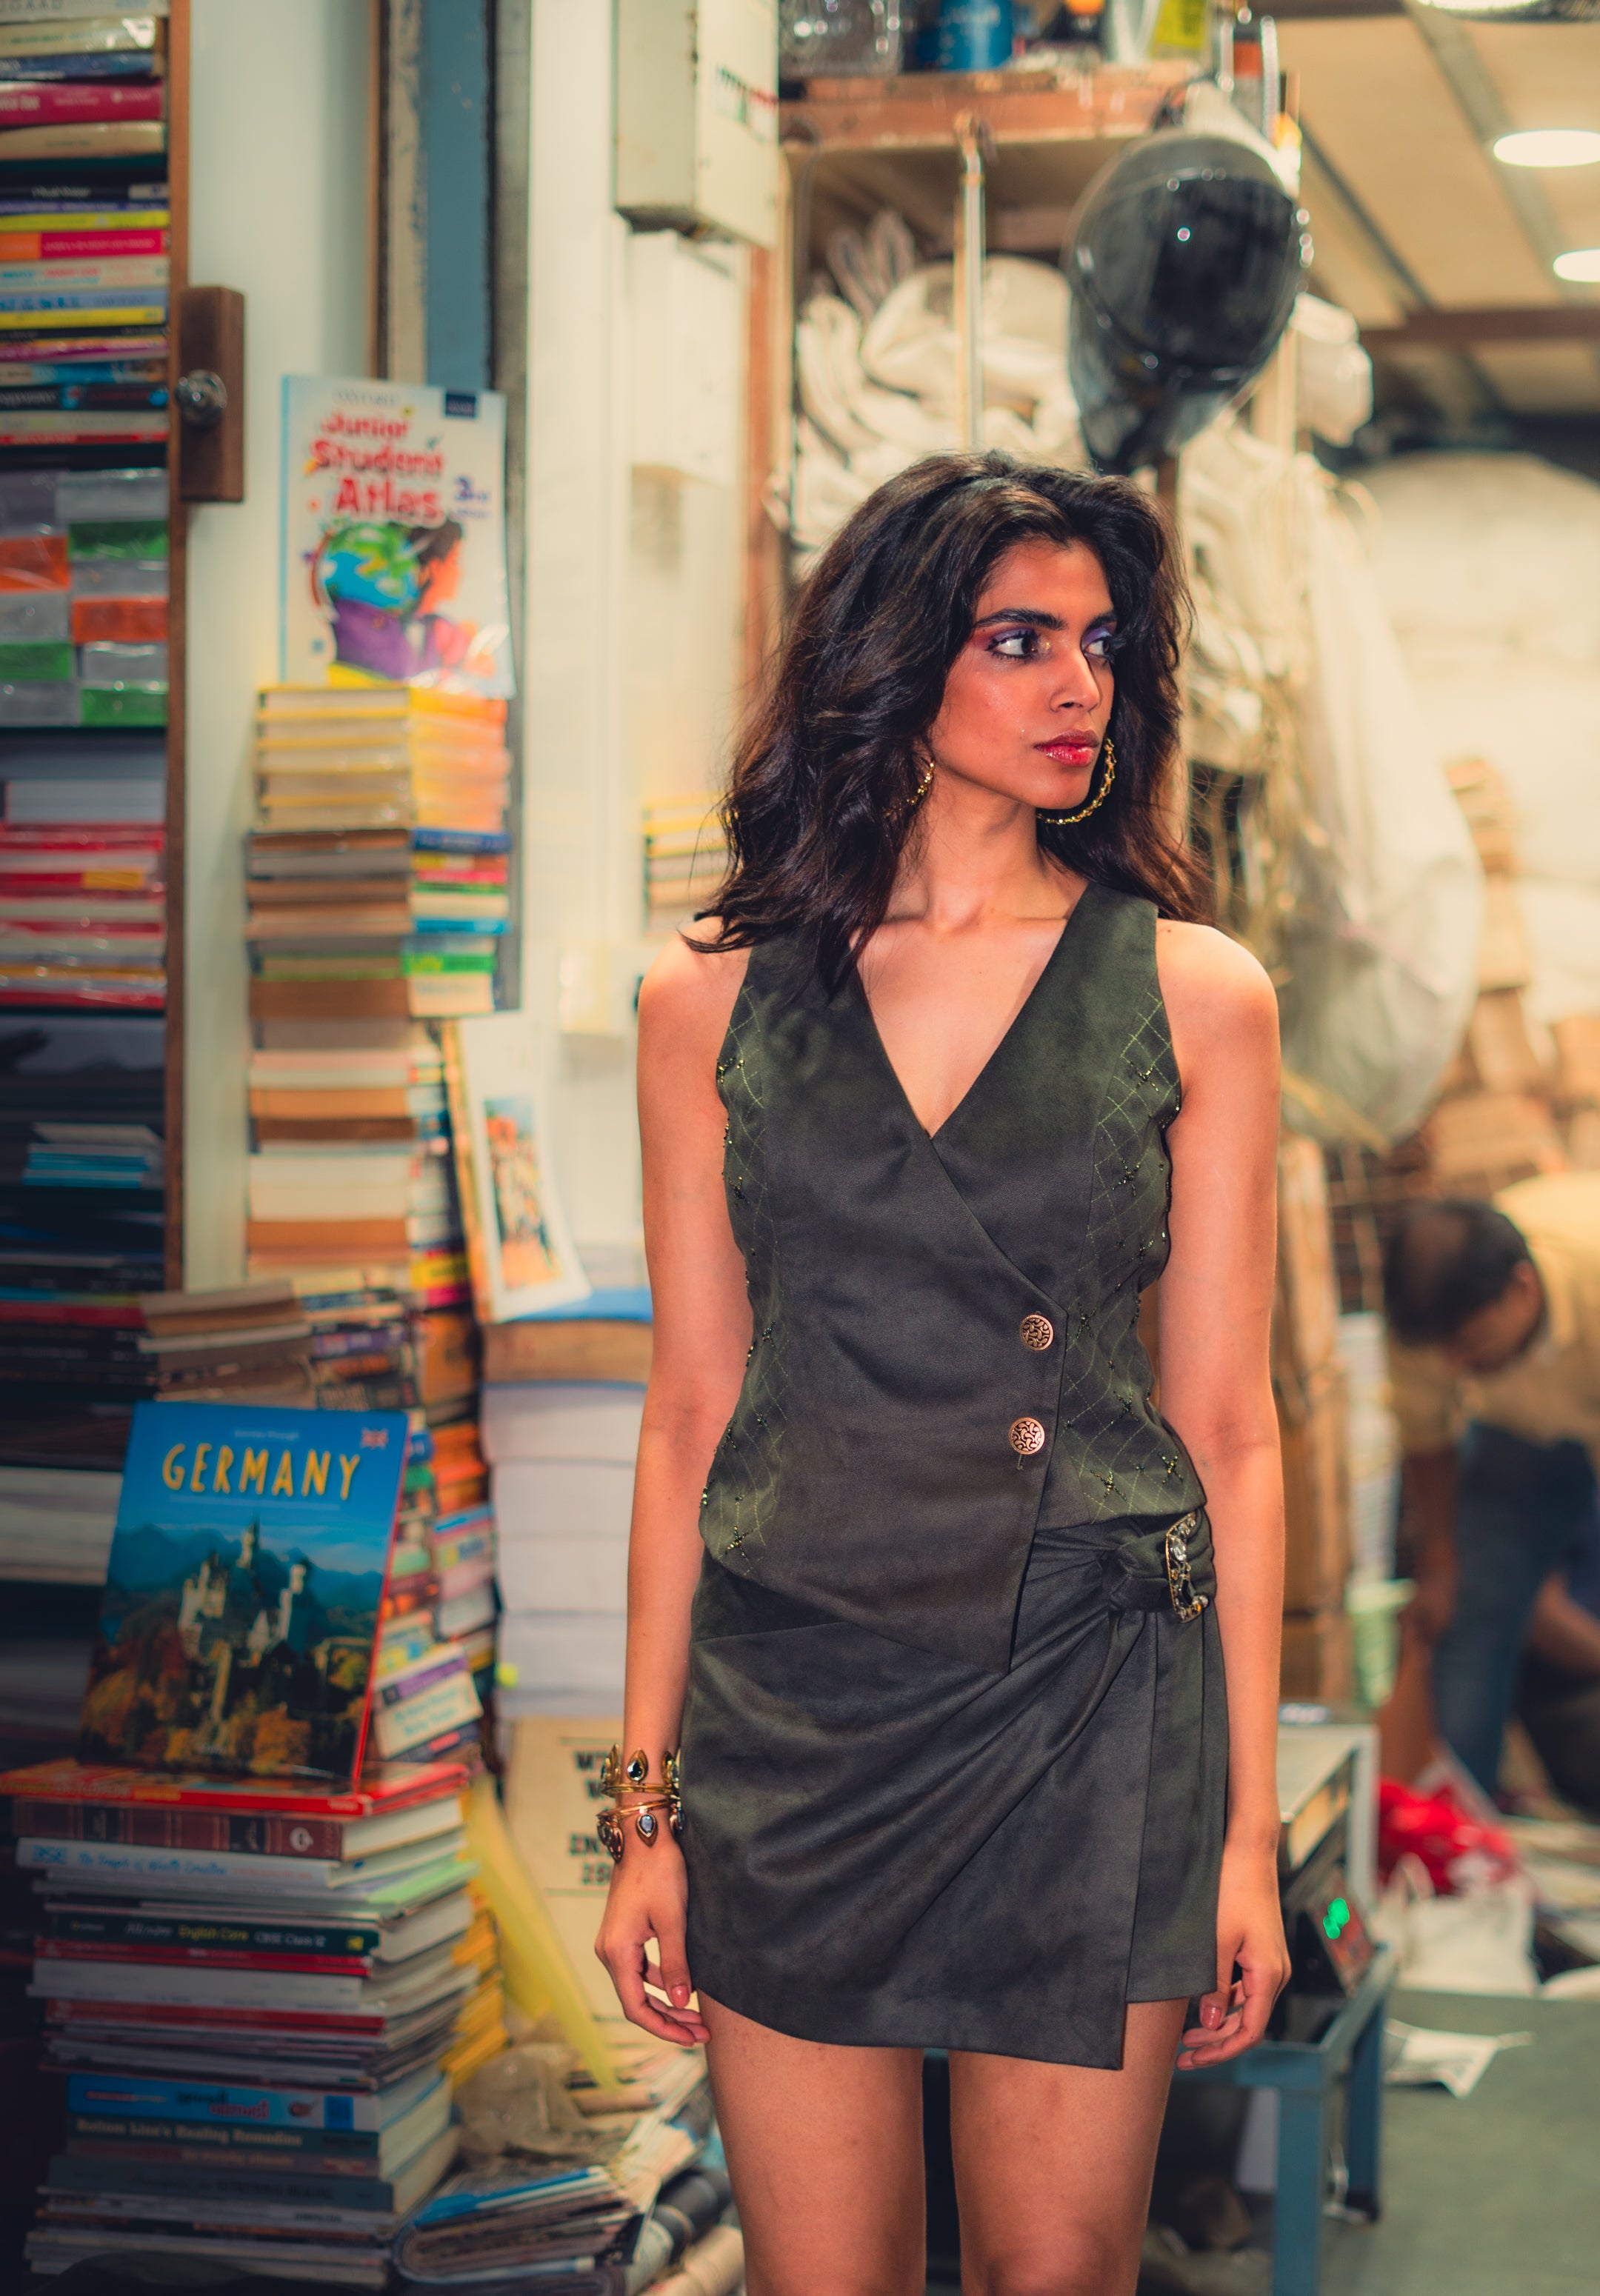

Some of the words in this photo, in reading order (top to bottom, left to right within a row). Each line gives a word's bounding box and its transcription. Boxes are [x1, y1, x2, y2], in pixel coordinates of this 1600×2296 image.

[321, 412, 410, 438] Junior
[310, 440, 446, 475] Student
[336, 477, 444, 520] Atlas
[161, 1442, 361, 1501] GERMANY
[178, 1925, 217, 1941] English
[219, 1928, 250, 1941] Core
